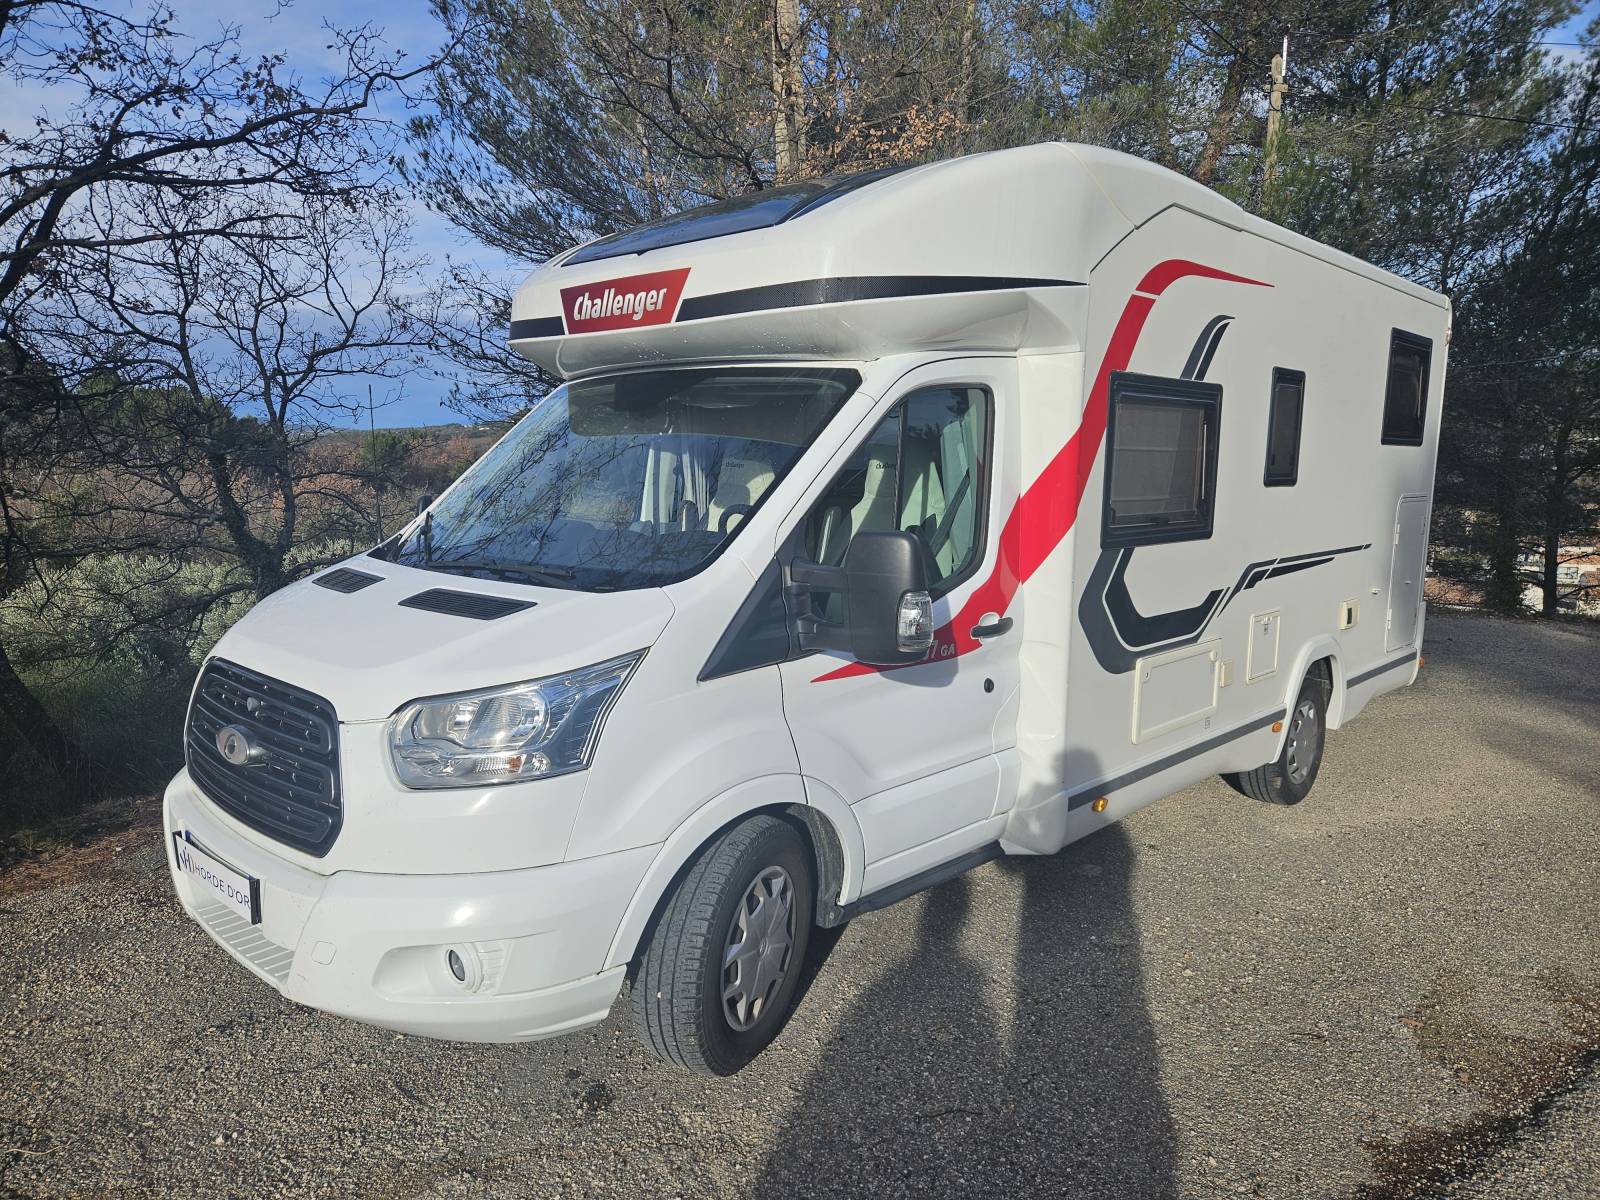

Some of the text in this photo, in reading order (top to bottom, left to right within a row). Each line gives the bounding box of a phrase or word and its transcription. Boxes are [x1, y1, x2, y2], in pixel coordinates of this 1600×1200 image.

[573, 287, 668, 321] Challenger
[940, 643, 955, 657] GA
[194, 863, 251, 910] HORDE D'OR
